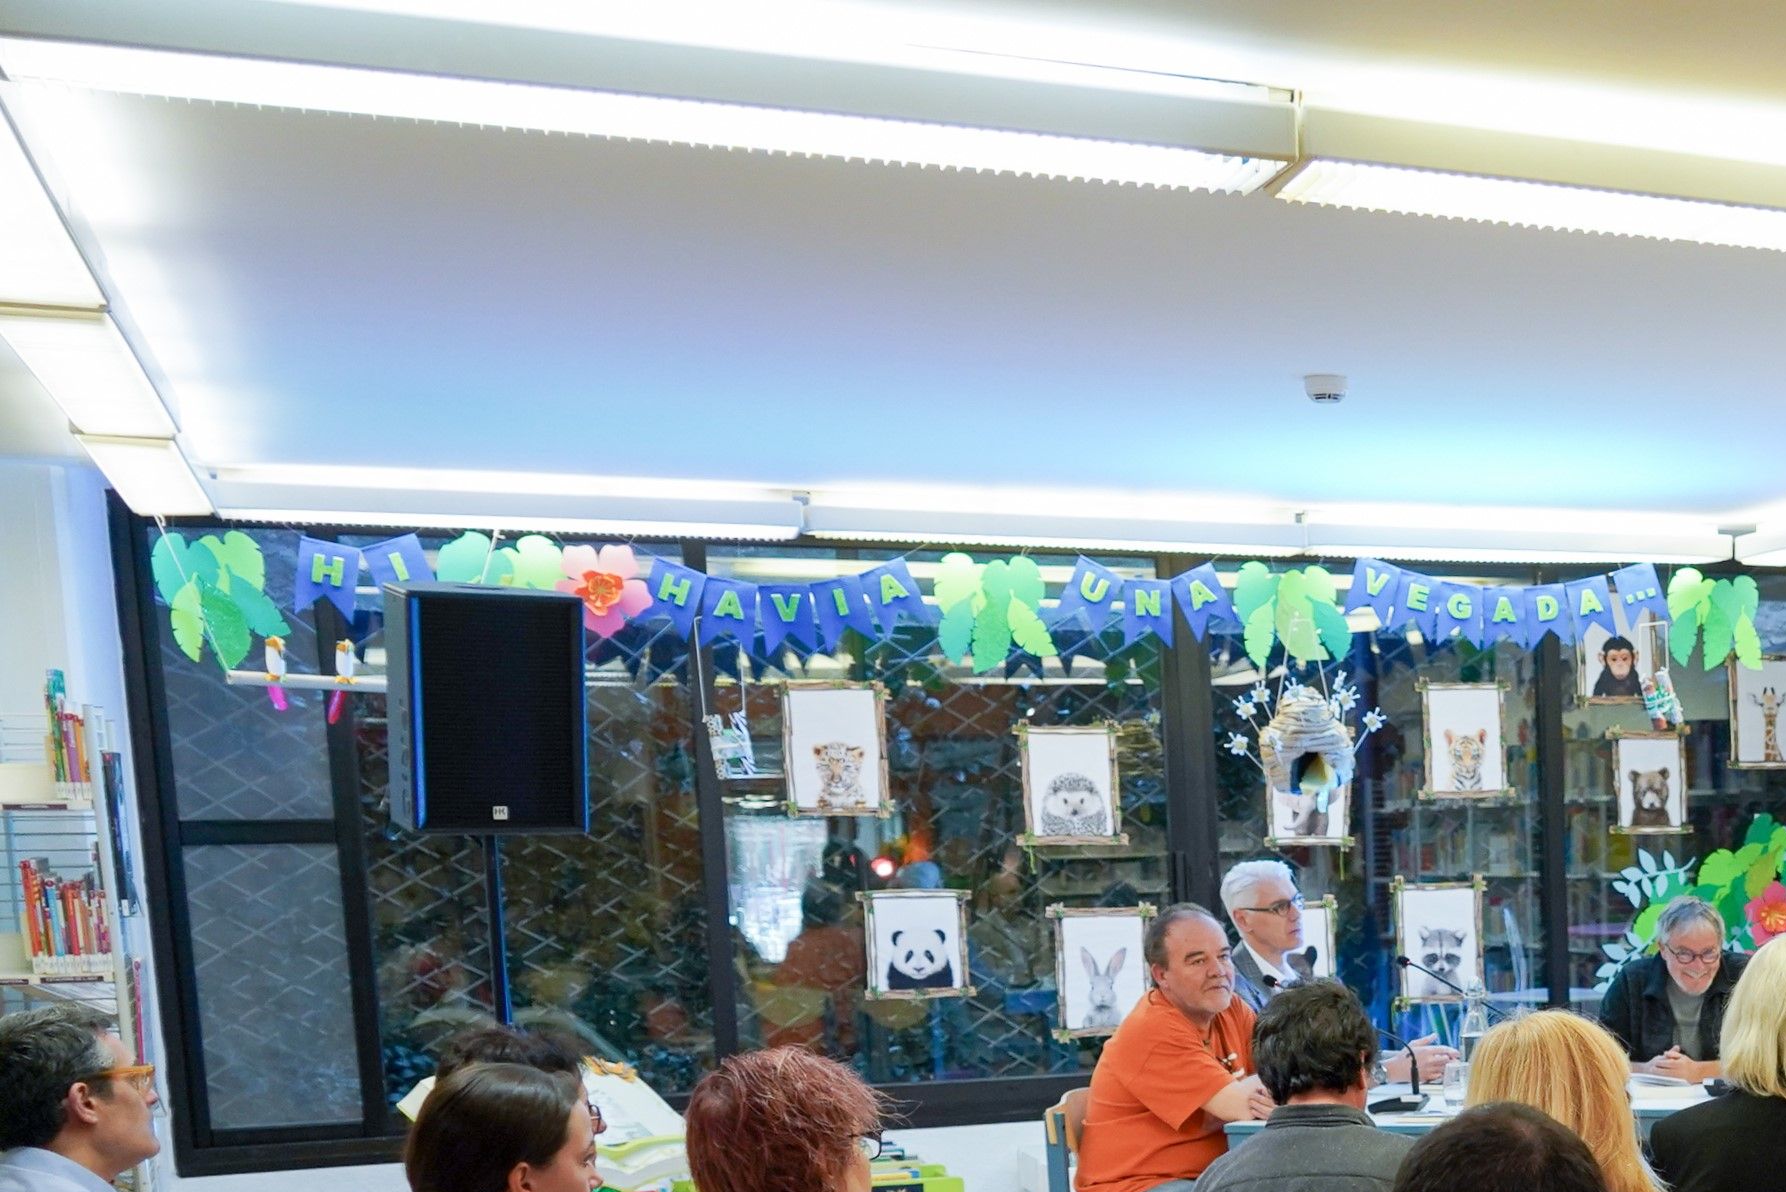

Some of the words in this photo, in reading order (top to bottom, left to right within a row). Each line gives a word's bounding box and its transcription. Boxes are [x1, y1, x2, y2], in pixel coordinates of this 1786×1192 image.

[311, 551, 411, 588] HI
[658, 573, 910, 622] HAVIA
[1080, 571, 1218, 617] UNA
